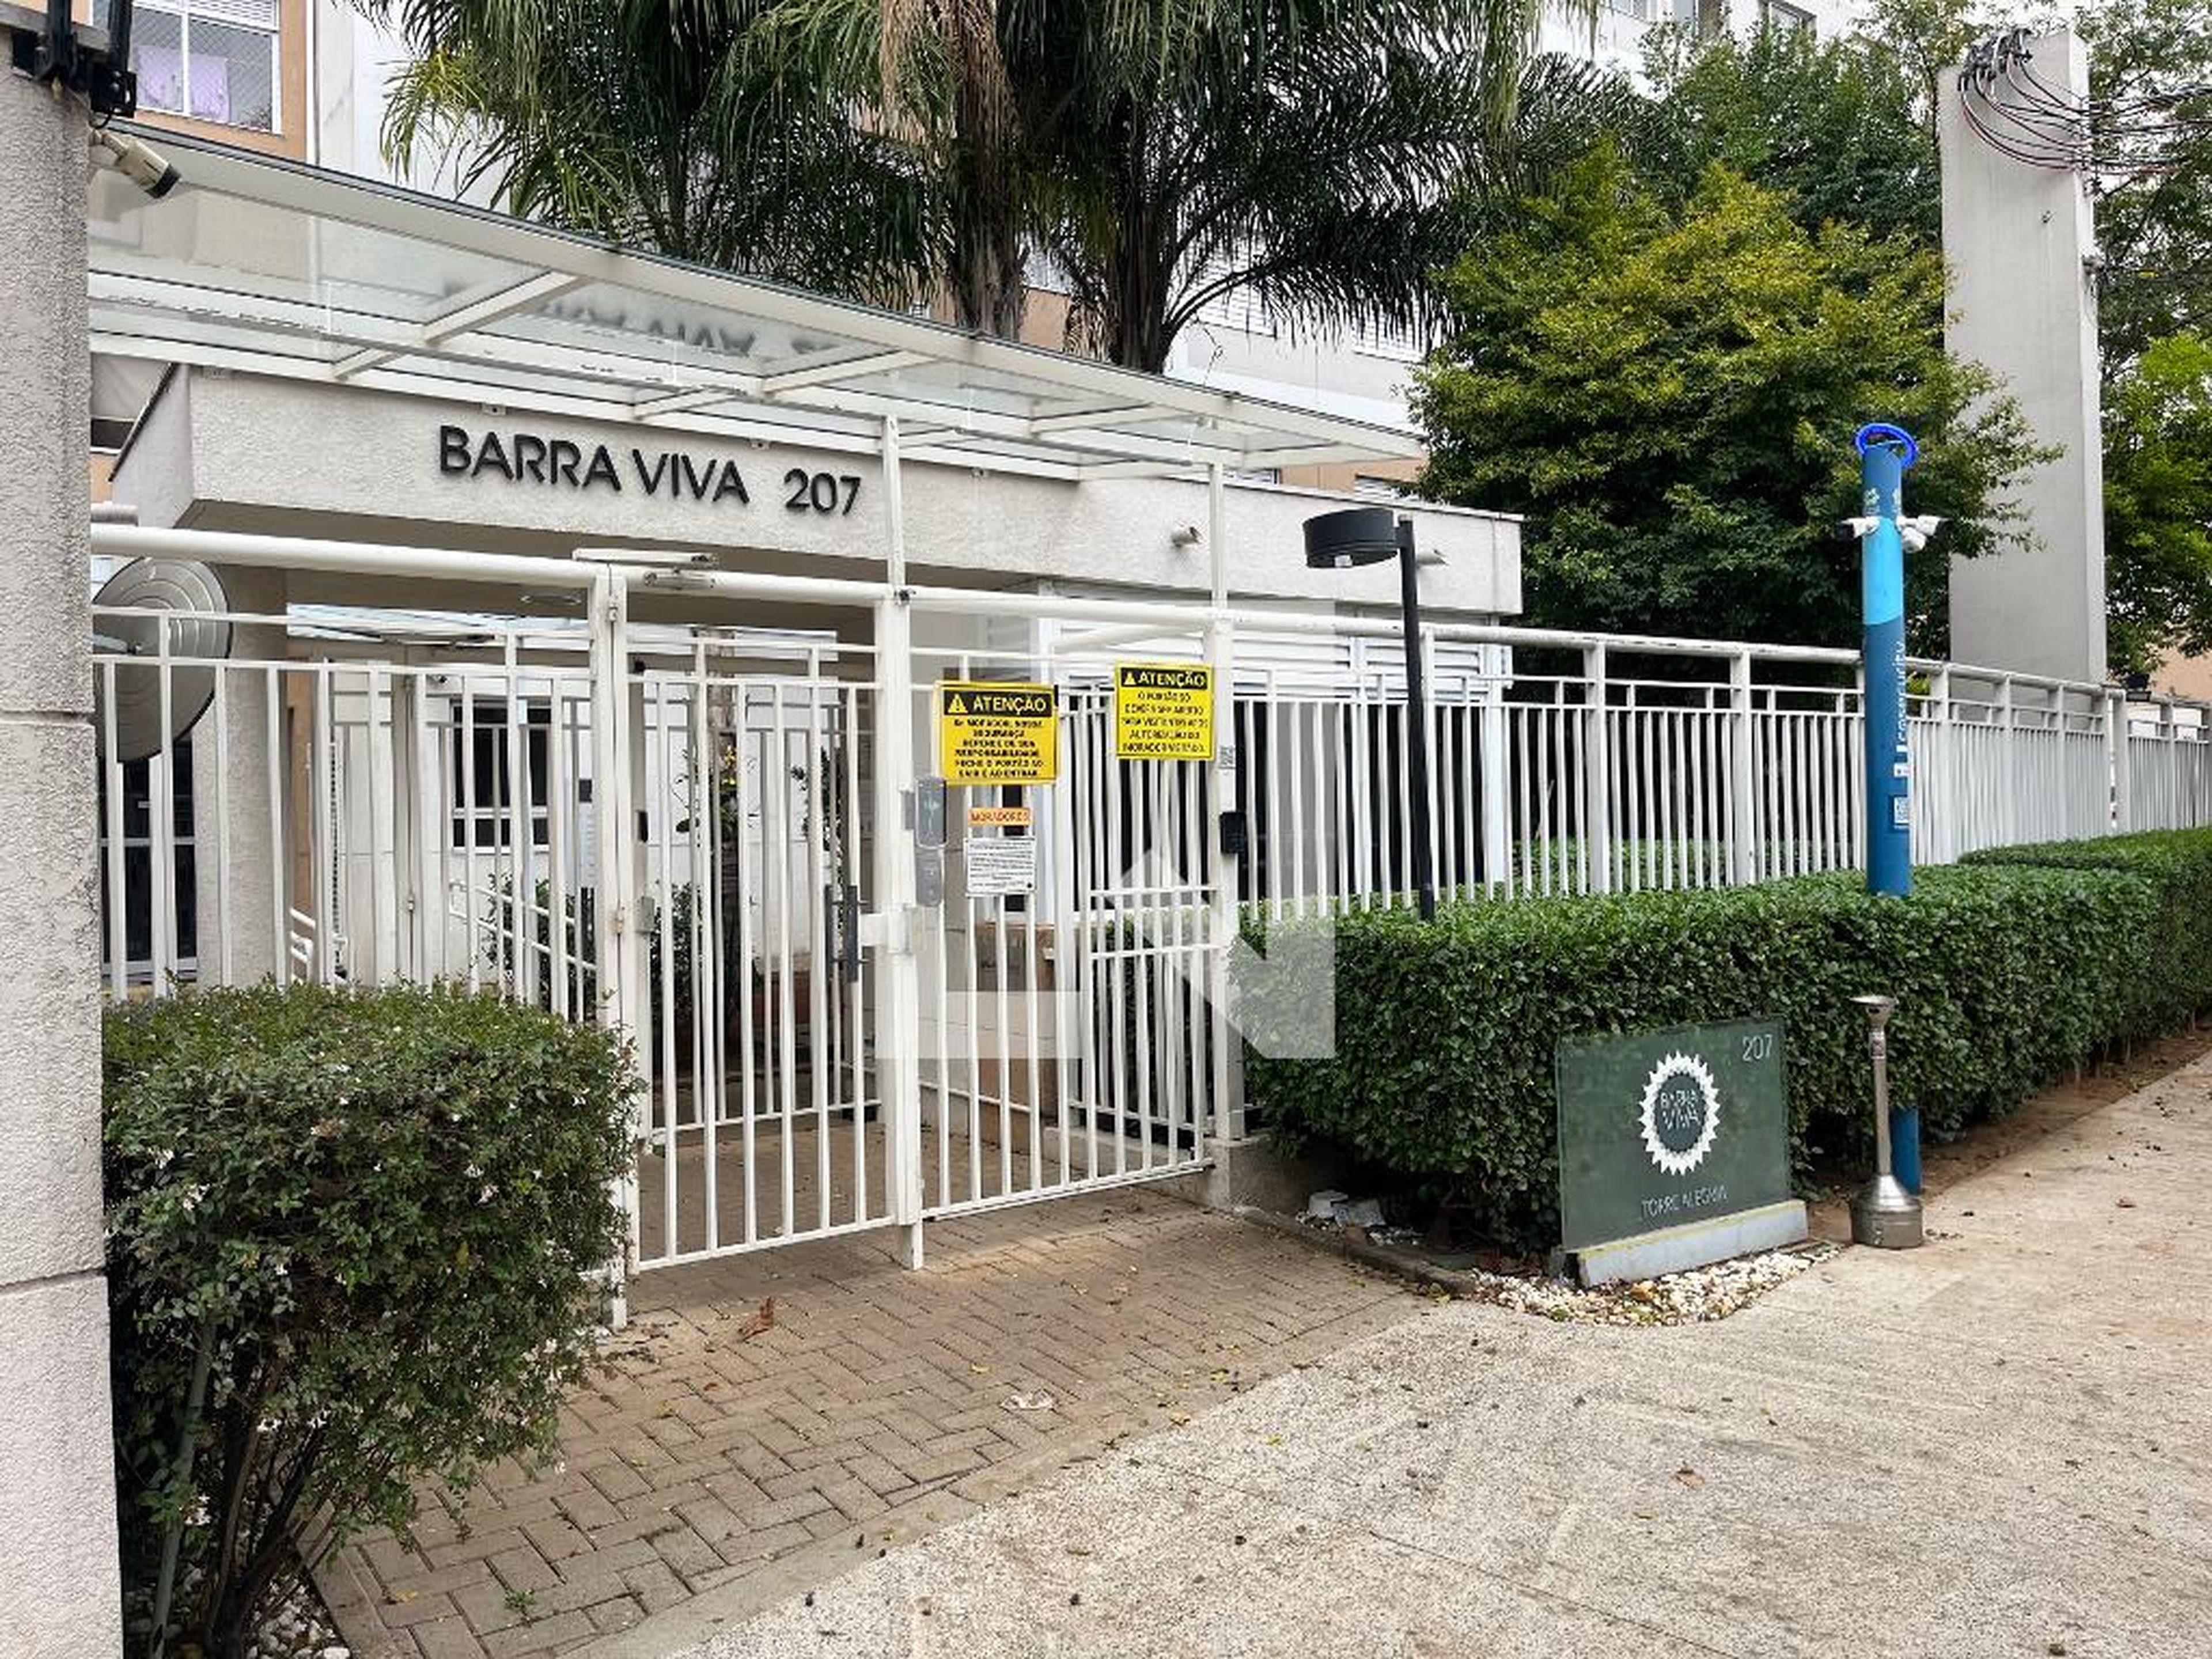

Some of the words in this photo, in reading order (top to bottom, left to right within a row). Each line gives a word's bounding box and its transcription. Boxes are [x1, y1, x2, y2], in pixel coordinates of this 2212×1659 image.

[439, 425, 622, 492] BARRA
[632, 449, 749, 505] VIVA
[783, 468, 862, 516] 207
[1138, 670, 1205, 687] ATENÇÃO
[972, 695, 1047, 715] ATENÇÃO
[1742, 1035, 1772, 1061] 207
[1642, 1194, 1680, 1217] TORRE
